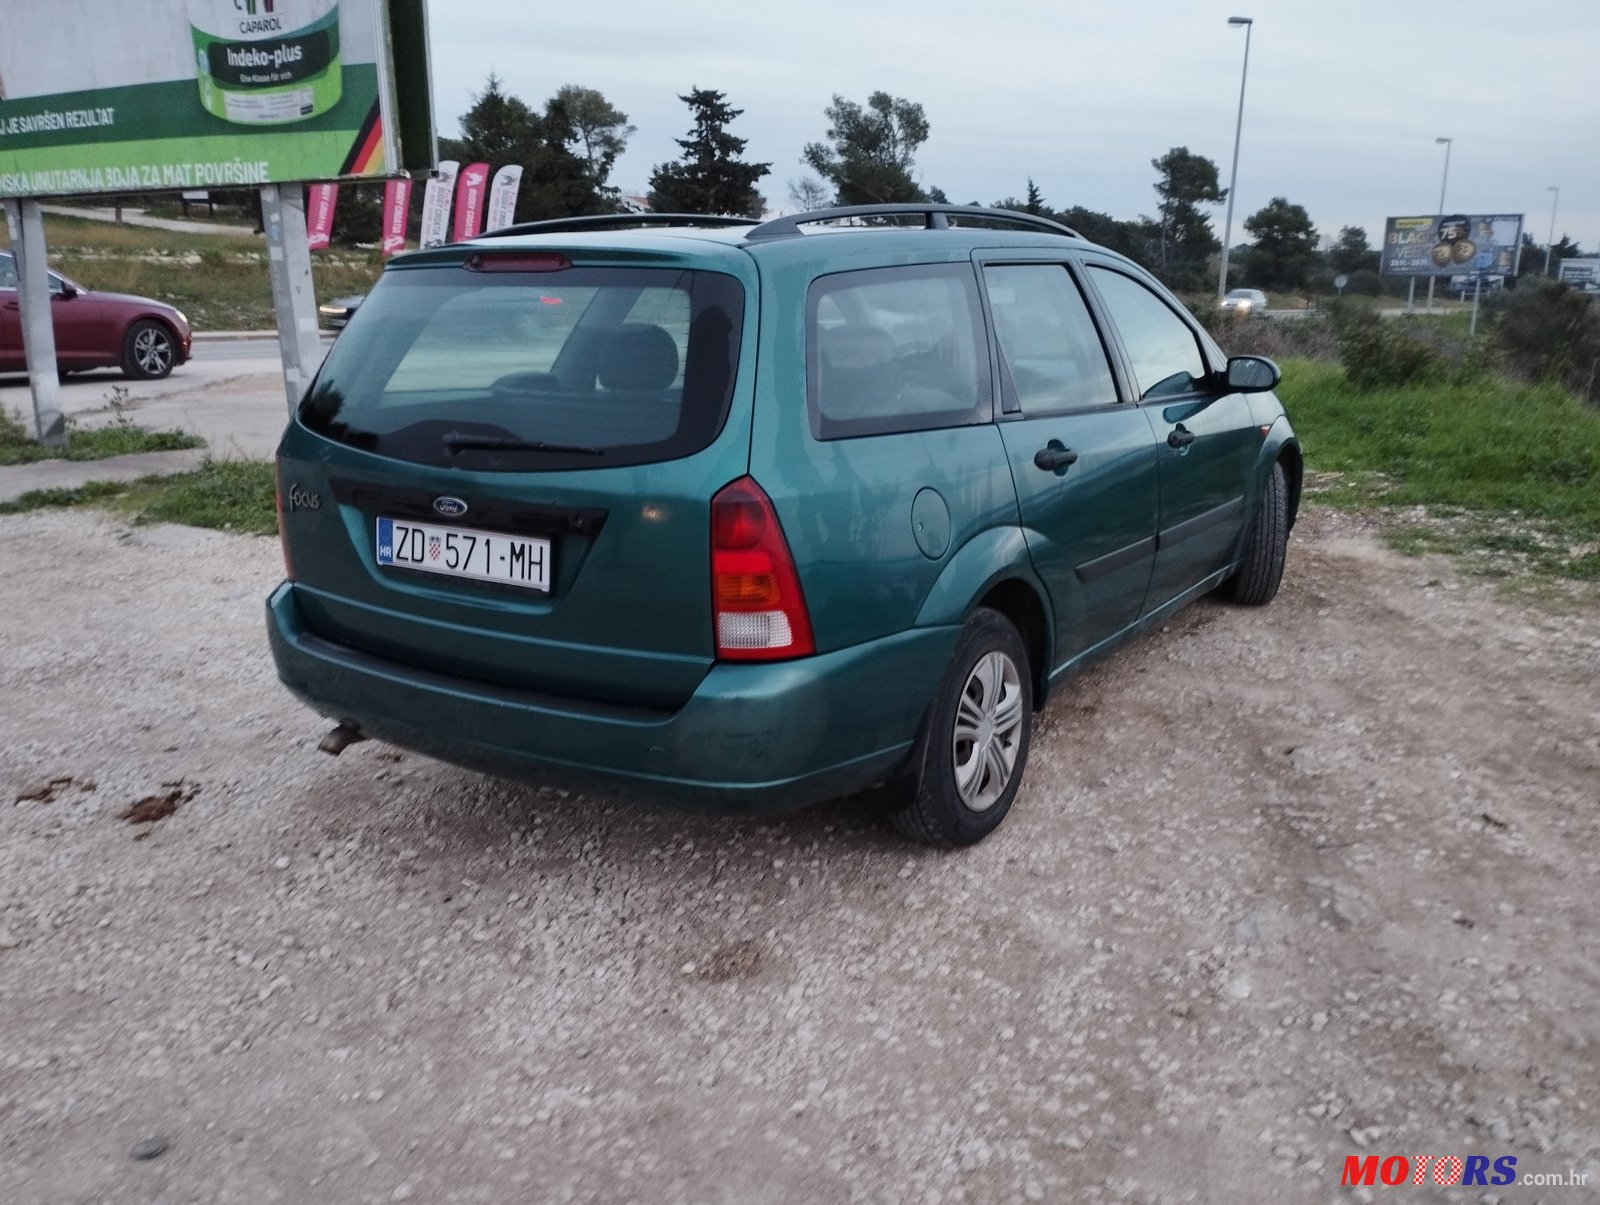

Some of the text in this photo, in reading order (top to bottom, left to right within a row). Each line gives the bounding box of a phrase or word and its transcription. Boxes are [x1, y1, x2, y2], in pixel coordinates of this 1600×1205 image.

[239, 18, 282, 34] CAPAROL
[227, 44, 302, 69] Indeko-plus
[7, 117, 20, 134] JE
[20, 110, 64, 133] SAVRŠEN
[65, 107, 115, 129] REZULTAT
[31, 168, 104, 192] UNUTARNJA
[105, 166, 140, 190] BOJA
[142, 165, 161, 187] ZA
[162, 164, 194, 187] MAT
[195, 157, 270, 185] POVRŠINE
[392, 205, 403, 233] CROATIA
[465, 209, 475, 237] CROATIA
[439, 500, 462, 514] Ford
[380, 545, 392, 559] HR
[395, 526, 543, 582] ZD 571-MH
